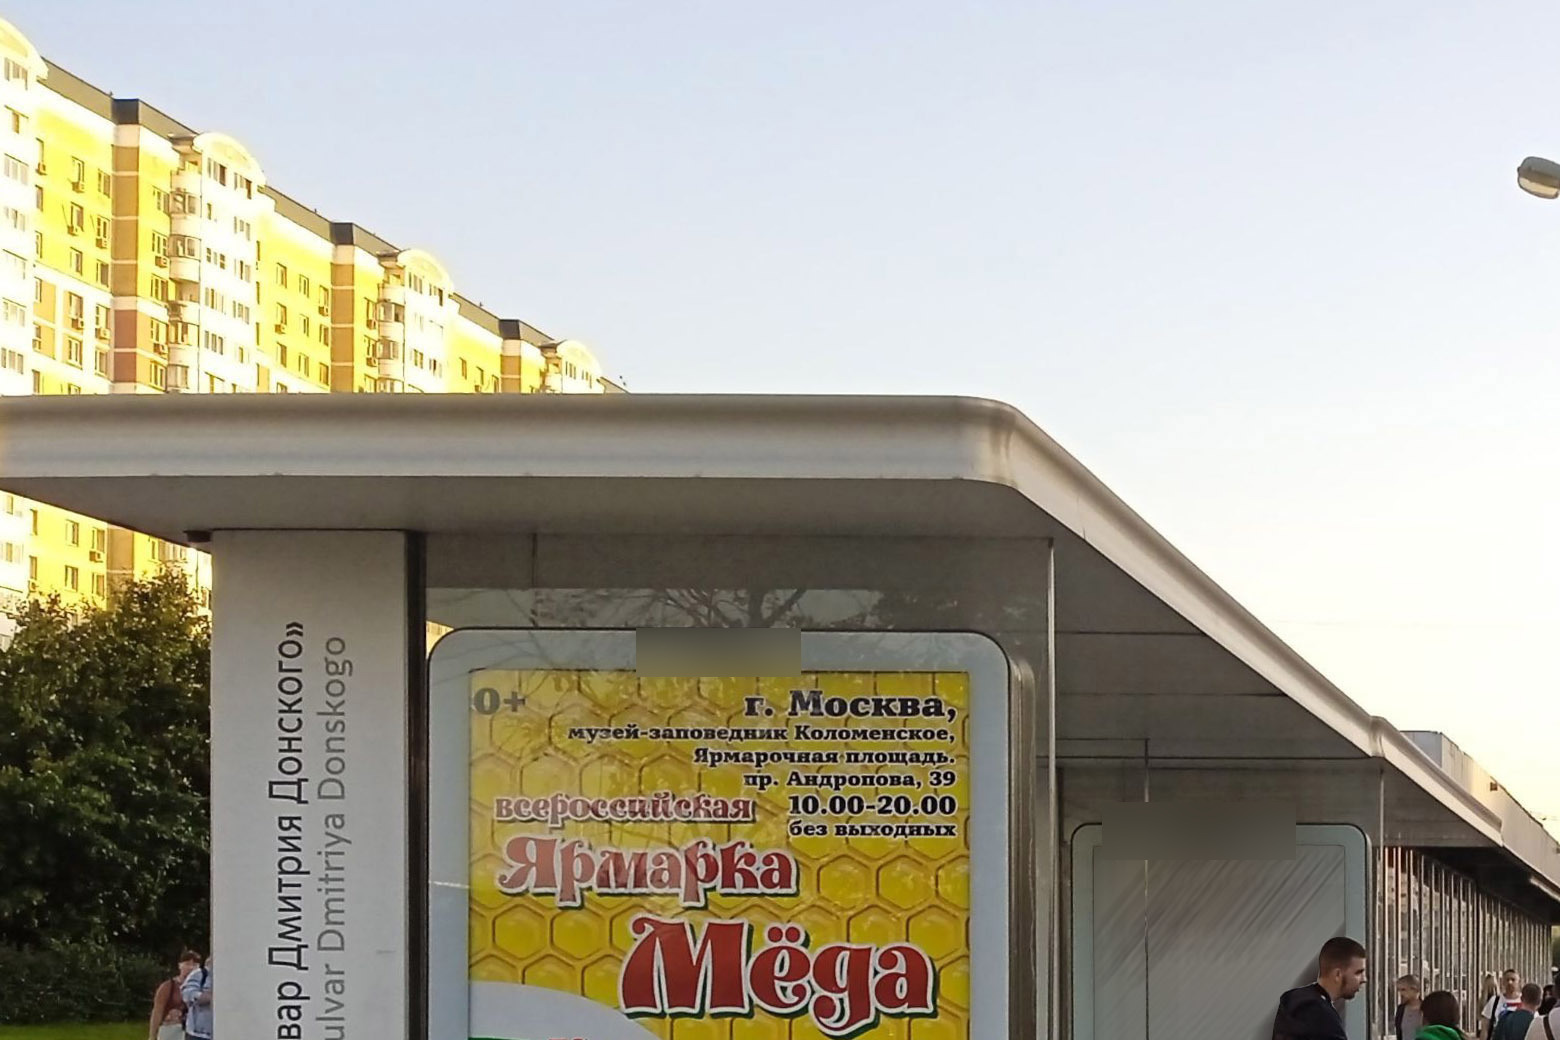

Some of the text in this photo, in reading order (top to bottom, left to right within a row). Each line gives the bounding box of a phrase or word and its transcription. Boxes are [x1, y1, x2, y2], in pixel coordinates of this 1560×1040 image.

[268, 620, 310, 804] Донского»
[316, 636, 354, 800] Donskogo
[473, 687, 526, 716] 0+
[743, 689, 958, 723] г. Москва,
[567, 723, 956, 745] музей-заповедник Коломенское,
[692, 747, 956, 768] Ярмарочная площадь.
[743, 770, 957, 791] пр. Андропова, 39
[493, 792, 755, 826] всероссийская
[788, 794, 957, 816] 10.00-20.00
[788, 820, 957, 838] без выходных
[316, 812, 352, 952] Dmitriya
[498, 834, 798, 908] Ярмарка
[267, 815, 311, 971] Дмитрия
[620, 914, 938, 1037] Мёда
